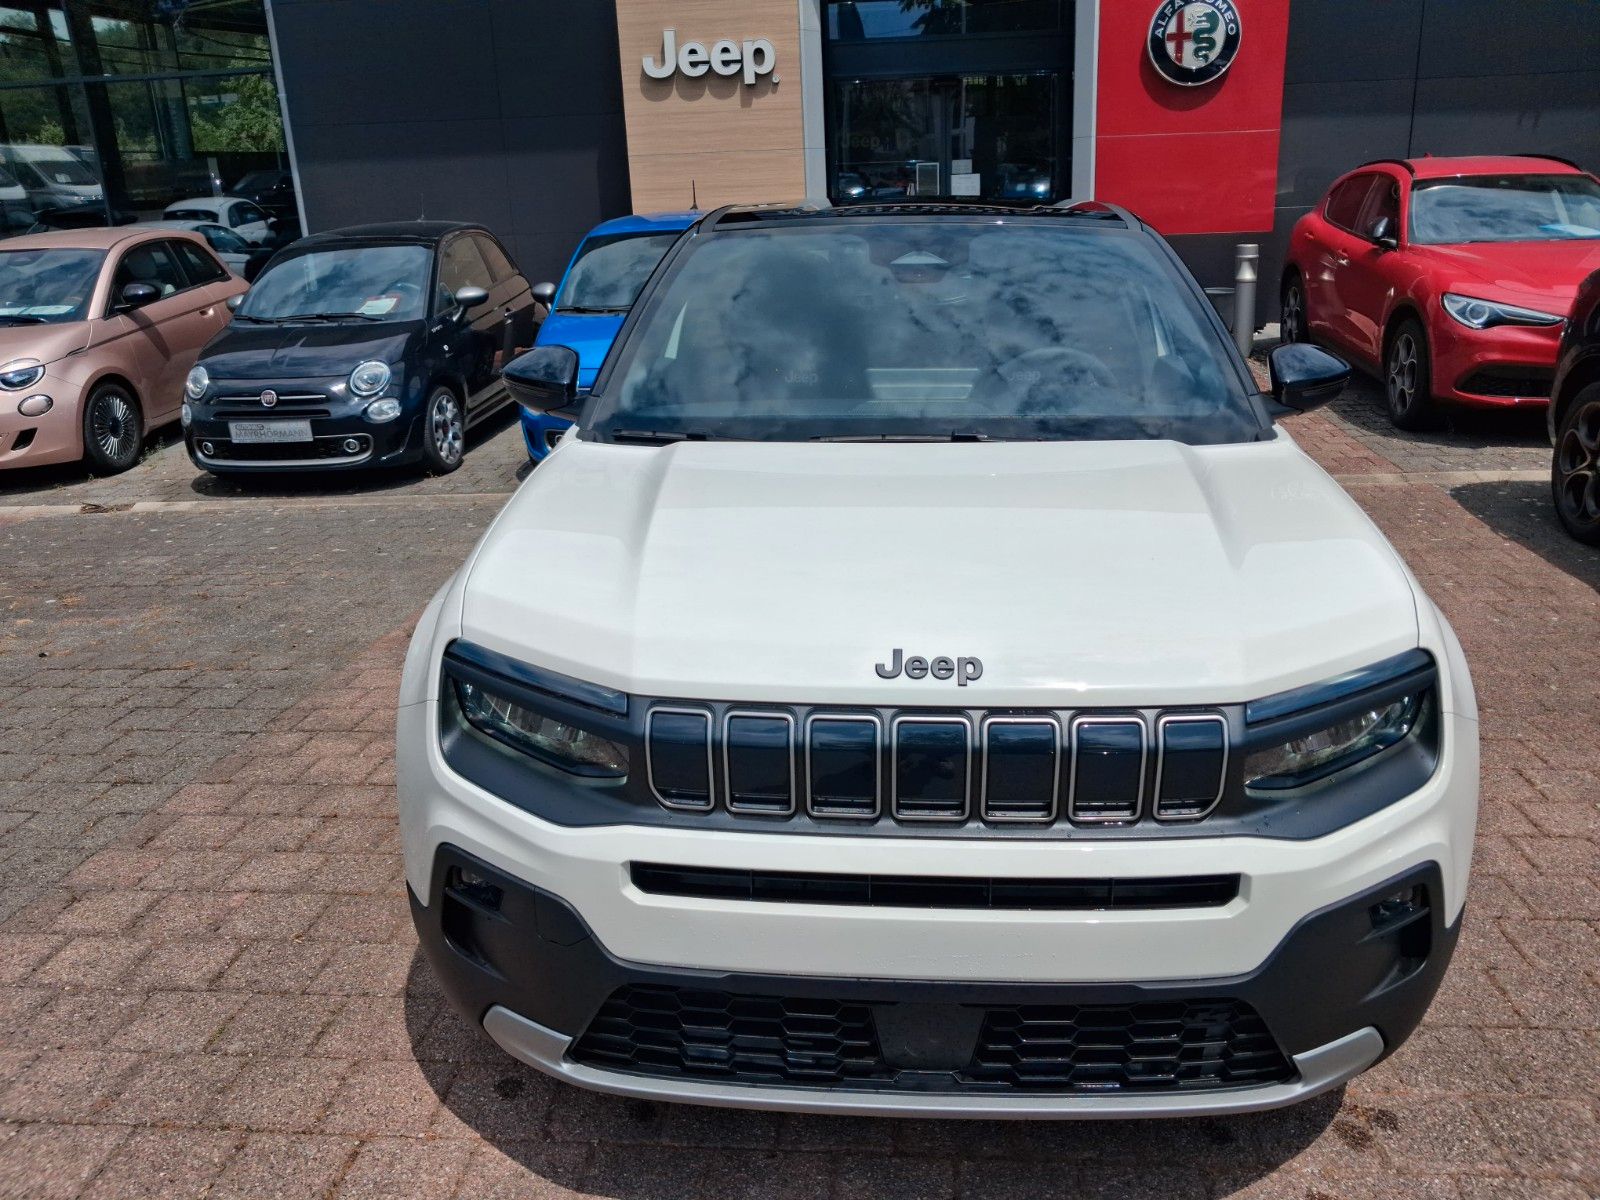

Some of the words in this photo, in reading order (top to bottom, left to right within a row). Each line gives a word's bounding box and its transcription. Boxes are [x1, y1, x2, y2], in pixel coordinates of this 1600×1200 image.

[1154, 0, 1184, 39] ALFA
[1196, 0, 1236, 36] MEO
[643, 29, 776, 84] Jeep
[784, 369, 818, 386] Jeep
[875, 648, 983, 686] Jeep
